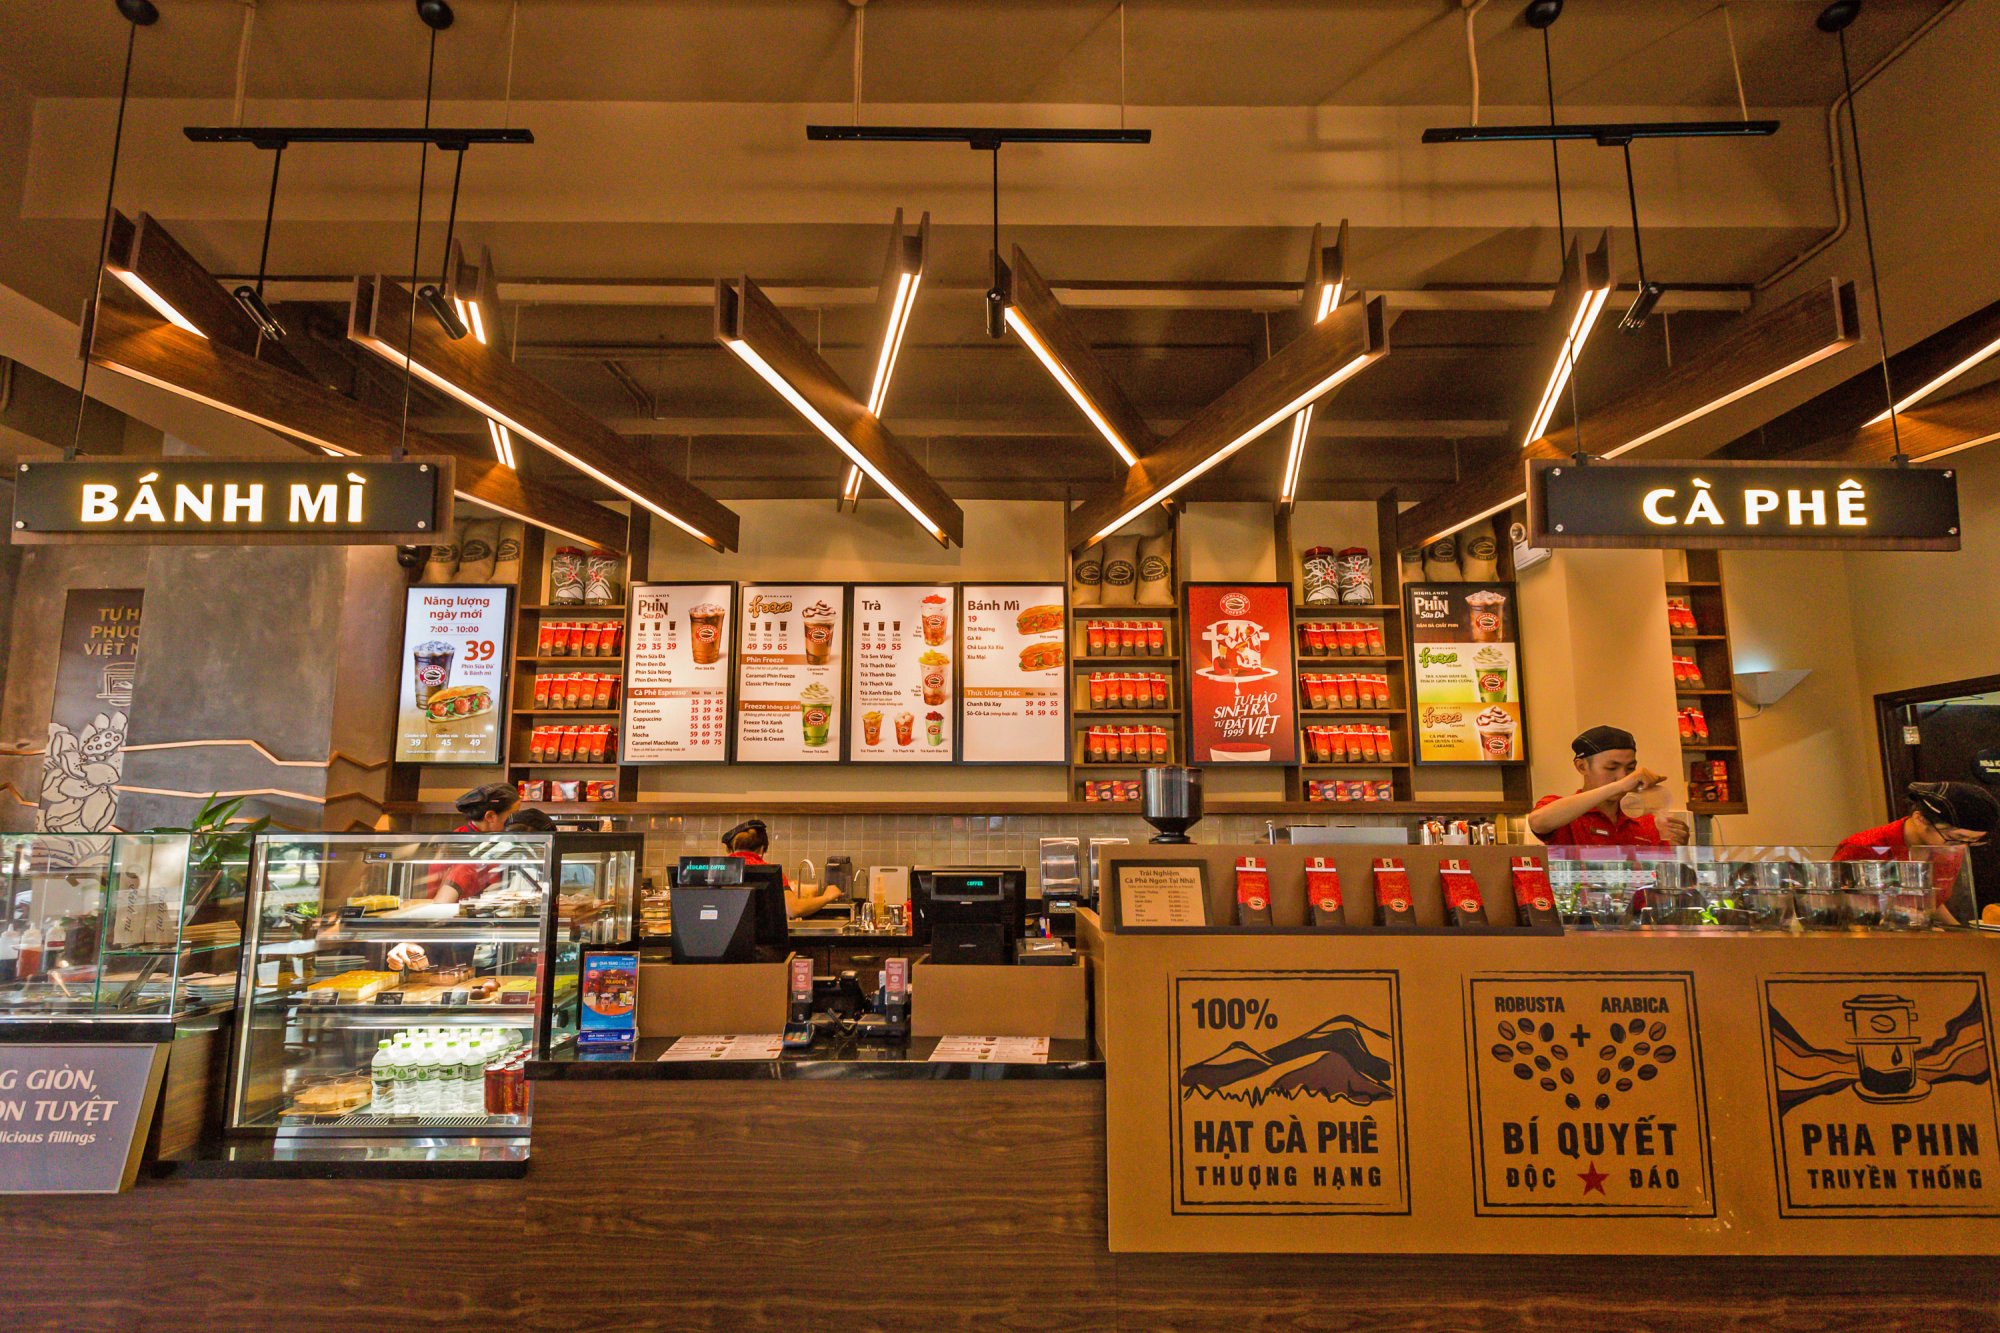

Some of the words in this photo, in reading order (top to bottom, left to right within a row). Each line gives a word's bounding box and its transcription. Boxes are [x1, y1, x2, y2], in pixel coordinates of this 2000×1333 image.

[81, 472, 263, 522] BÁNH
[289, 472, 366, 522] MÌ
[1642, 478, 1725, 525] CÀ
[1744, 478, 1867, 525] PHÊ
[424, 597, 454, 608] Năng
[457, 596, 490, 608] lượng
[638, 598, 668, 615] PHIN
[862, 600, 881, 610] Trà
[968, 600, 1000, 611] Bánh
[1004, 600, 1020, 611] Mì
[1414, 596, 1449, 615] PHIN
[98, 606, 125, 624] TỰ
[429, 610, 457, 620] ngày
[460, 610, 482, 619] mới
[84, 639, 125, 658] VIỆT
[464, 640, 495, 661] 39
[1234, 694, 1251, 707] TỰ
[1250, 691, 1277, 704] HÀO
[1213, 704, 1249, 718] SINH
[1250, 704, 1269, 715] RA
[1223, 729, 1244, 737] 1999
[1225, 715, 1249, 729] ĐẤT
[1248, 713, 1280, 738] VIỆT
[1192, 998, 1278, 1029] 100%
[1495, 997, 1565, 1013] ROBUSTA
[1601, 997, 1669, 1013] ARABICA
[26, 1064, 97, 1092] GIÒN,
[35, 1095, 118, 1126] TUYỆT
[48, 1131, 96, 1145] fillings
[1194, 1120, 1253, 1159] HẠT
[1265, 1115, 1308, 1153] CÀ
[1318, 1115, 1379, 1154] PHÊ
[1503, 1116, 1539, 1154] BÍ
[1558, 1115, 1677, 1159] QUYẾT
[1801, 1124, 1876, 1156] PHA
[1891, 1124, 1979, 1156] PHIN
[1196, 1165, 1297, 1190] THƯỢNG
[1314, 1166, 1381, 1190] HẠNG
[1506, 1164, 1556, 1191] ĐỘC
[1629, 1165, 1679, 1188] ĐÁO
[1807, 1164, 1896, 1189] TRUYỀN
[1907, 1164, 1982, 1189] THỐNG
